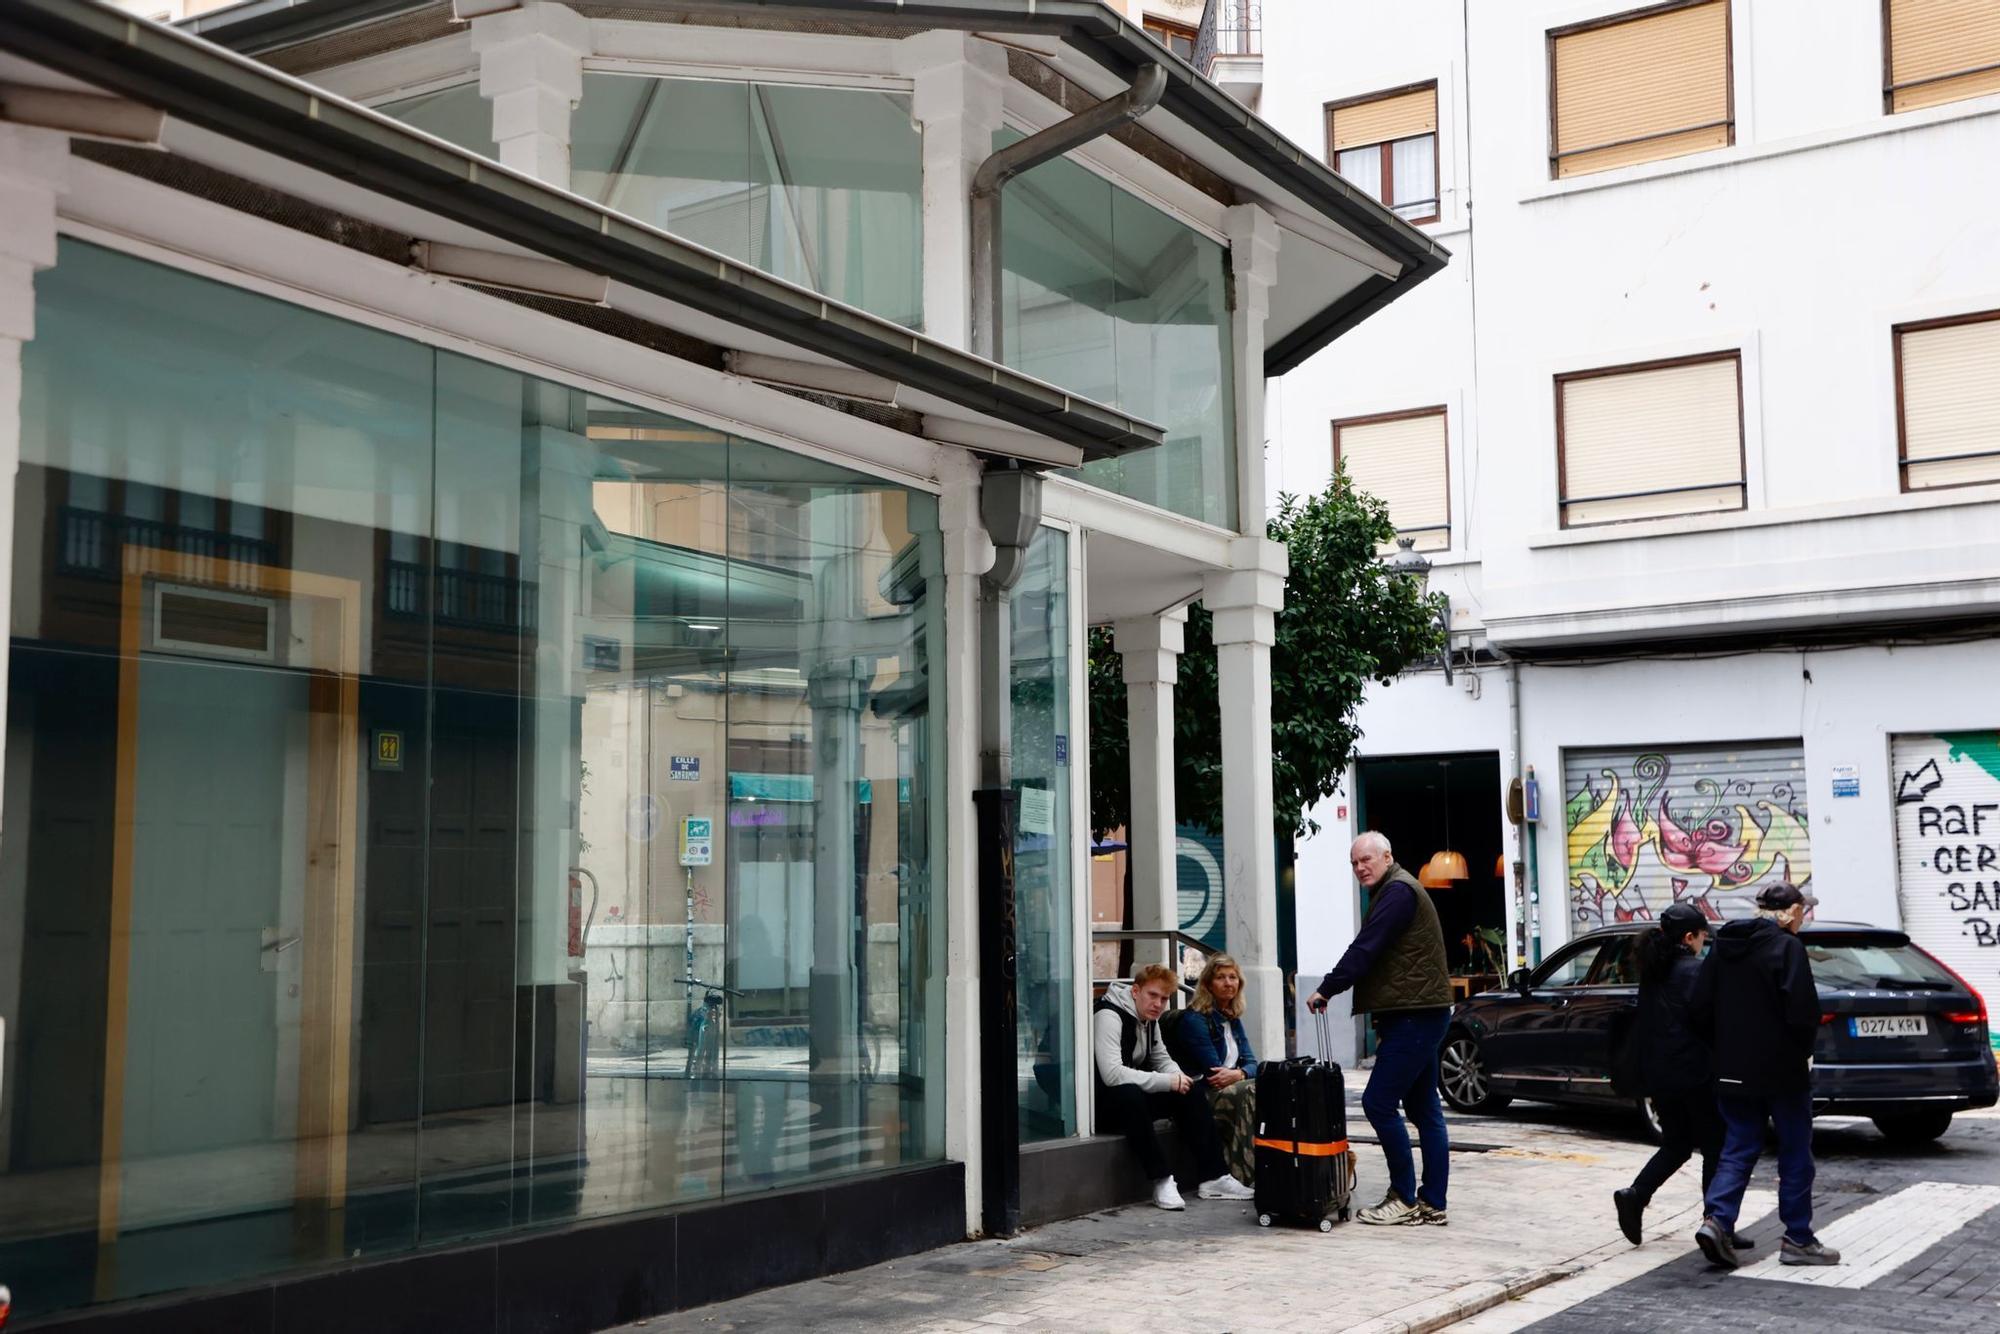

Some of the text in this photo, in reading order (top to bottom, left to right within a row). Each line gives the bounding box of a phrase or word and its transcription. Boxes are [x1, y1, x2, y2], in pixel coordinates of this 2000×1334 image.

[1934, 844, 2000, 874] CER
[1963, 918, 2000, 947] B
[1861, 1019, 1894, 1034] 0274
